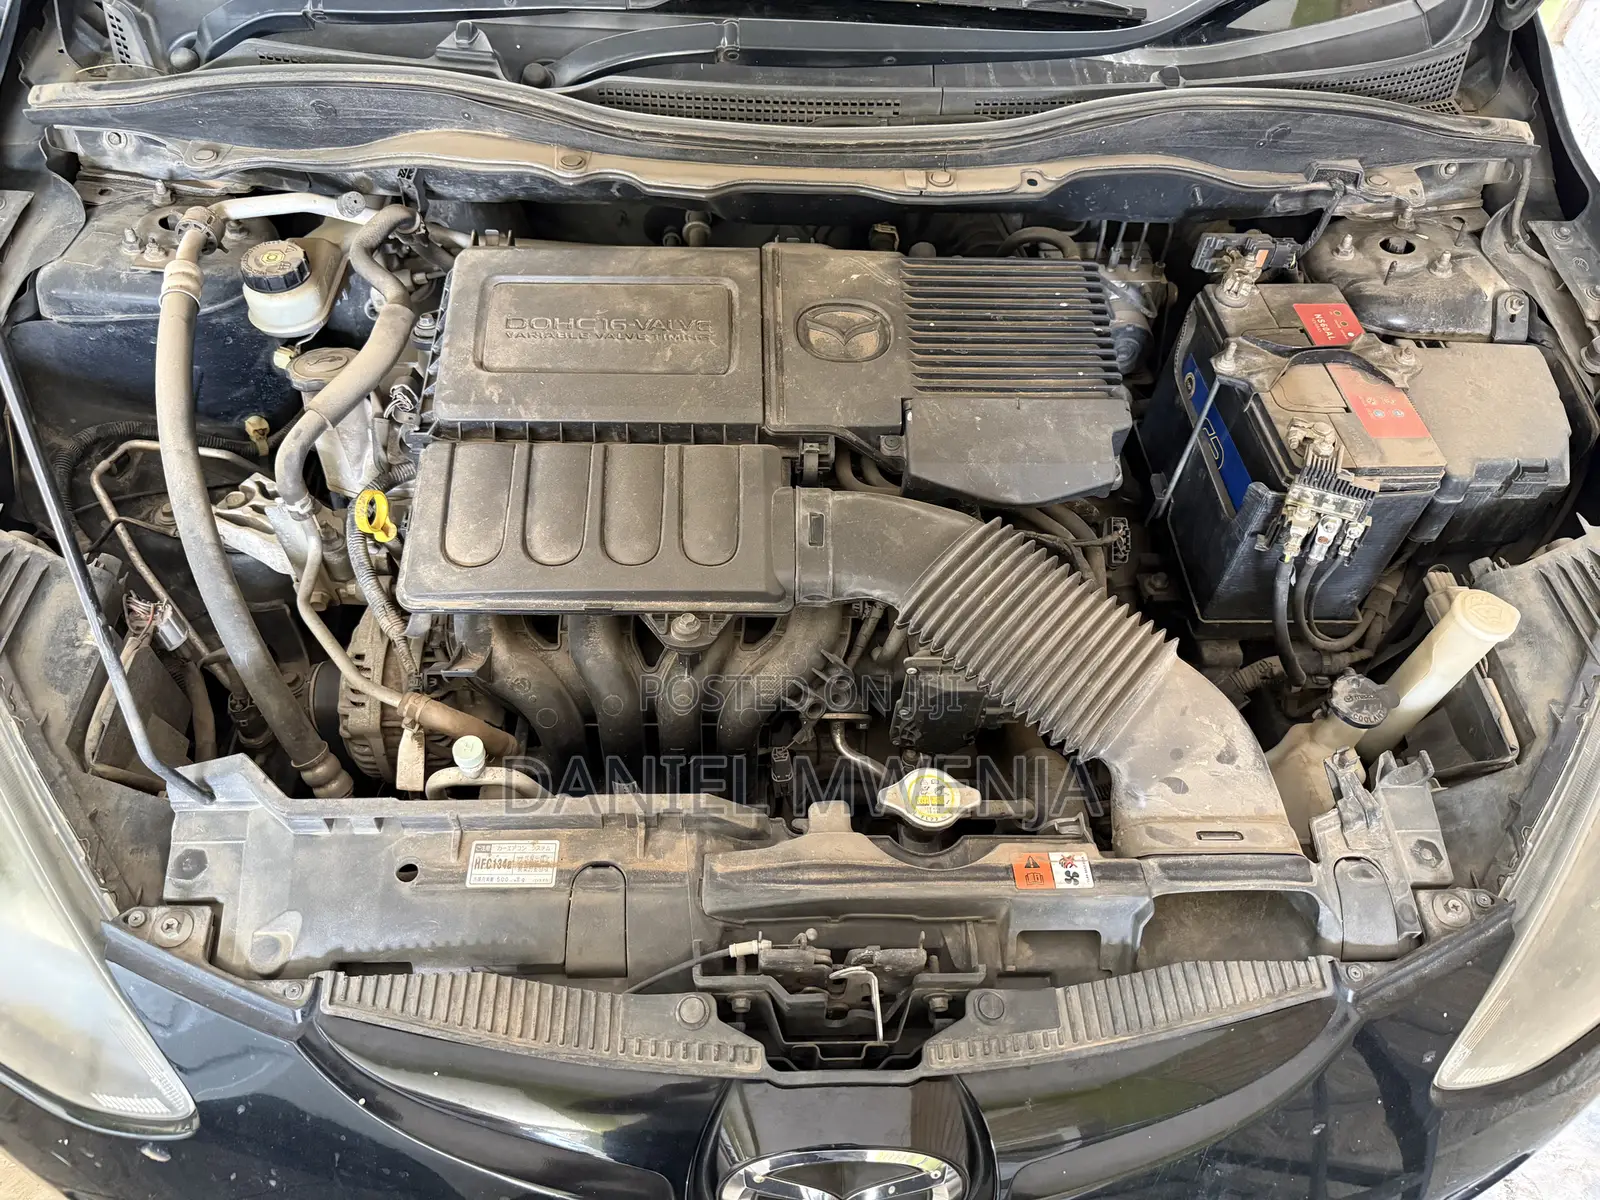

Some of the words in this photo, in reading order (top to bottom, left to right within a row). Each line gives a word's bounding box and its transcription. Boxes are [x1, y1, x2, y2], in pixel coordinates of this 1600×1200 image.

[505, 316, 596, 331] DOHC
[505, 331, 590, 340] VARIABLE
[595, 332, 647, 341] VALVE
